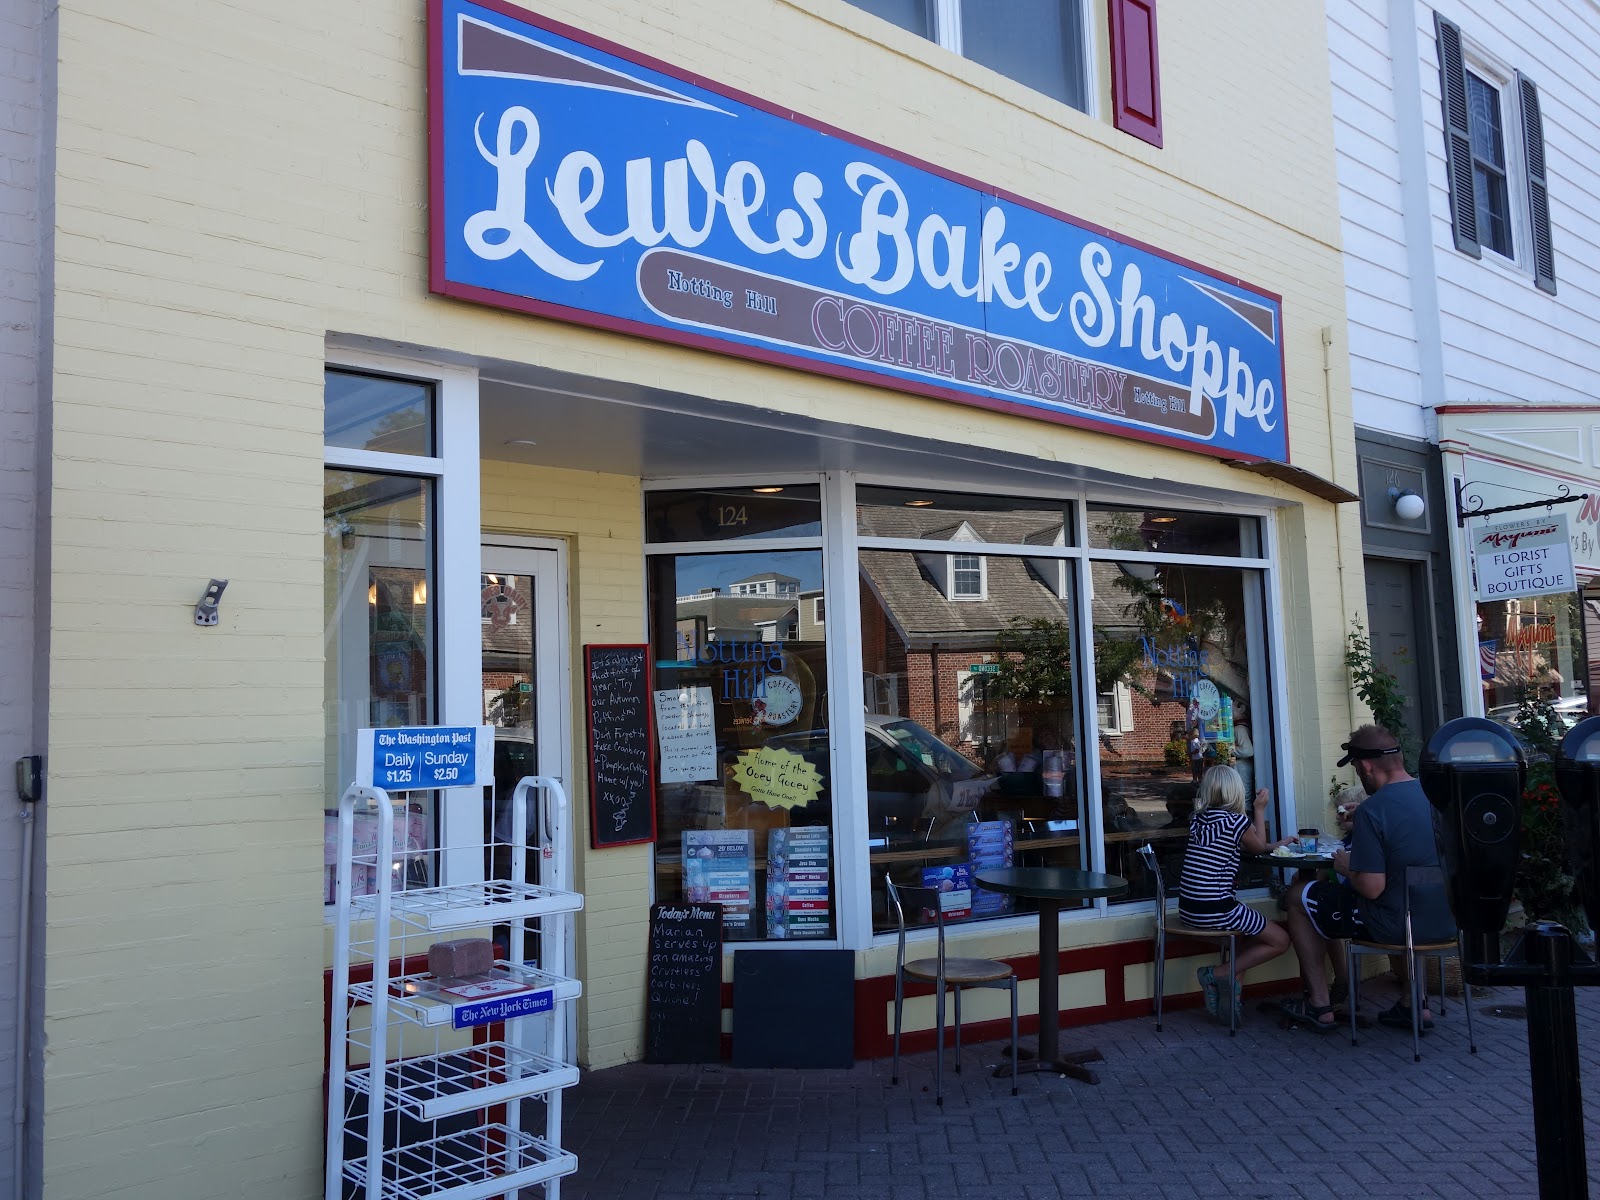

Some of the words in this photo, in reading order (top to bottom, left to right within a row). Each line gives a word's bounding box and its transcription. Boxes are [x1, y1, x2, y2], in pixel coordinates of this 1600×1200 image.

[464, 105, 828, 282] Lewes
[835, 161, 1063, 323] Bake
[1069, 241, 1277, 438] Shoppe
[667, 269, 733, 308] Notting
[745, 289, 777, 315] Hill
[811, 296, 956, 379] COFFEE
[966, 333, 1127, 415] ROASTERY
[1133, 386, 1167, 414] Notting
[1168, 395, 1186, 413] Hill
[717, 505, 748, 527] 124
[1494, 521, 1530, 531] FLOWERS
[1536, 518, 1546, 526] BY
[1582, 531, 1595, 560] By
[1493, 547, 1550, 566] FLORIST
[1504, 563, 1543, 578] GIFTS
[1487, 574, 1564, 594] BOUTIQUE
[675, 629, 788, 673] Notting
[1136, 635, 1211, 677] Notting
[618, 677, 633, 692] Try
[722, 665, 768, 699] Hill
[767, 680, 797, 695] COFFEE
[1173, 671, 1201, 698] Hill
[1199, 682, 1217, 696] COFFEE
[592, 699, 605, 707] our
[610, 692, 640, 706] Autumn
[659, 691, 688, 703] Smok
[767, 700, 799, 721] ROASTERY
[379, 733, 396, 747] The
[397, 731, 451, 747] Washington
[451, 732, 472, 746] Post
[384, 752, 416, 769] Daily
[424, 750, 469, 767] Sunday
[614, 741, 646, 761] Cranberry
[754, 752, 777, 768] Home
[780, 760, 791, 773] of
[792, 763, 807, 775] the
[386, 769, 412, 783] $1.25
[433, 767, 459, 781] $2.50
[656, 905, 690, 922] Today's
[689, 906, 716, 920] Menu
[652, 922, 704, 938] Marian
[652, 953, 669, 963] an
[671, 953, 714, 972] amazing
[461, 1009, 479, 1022] The
[479, 1005, 501, 1020] New
[499, 1000, 522, 1018] York
[522, 997, 548, 1011] Times
